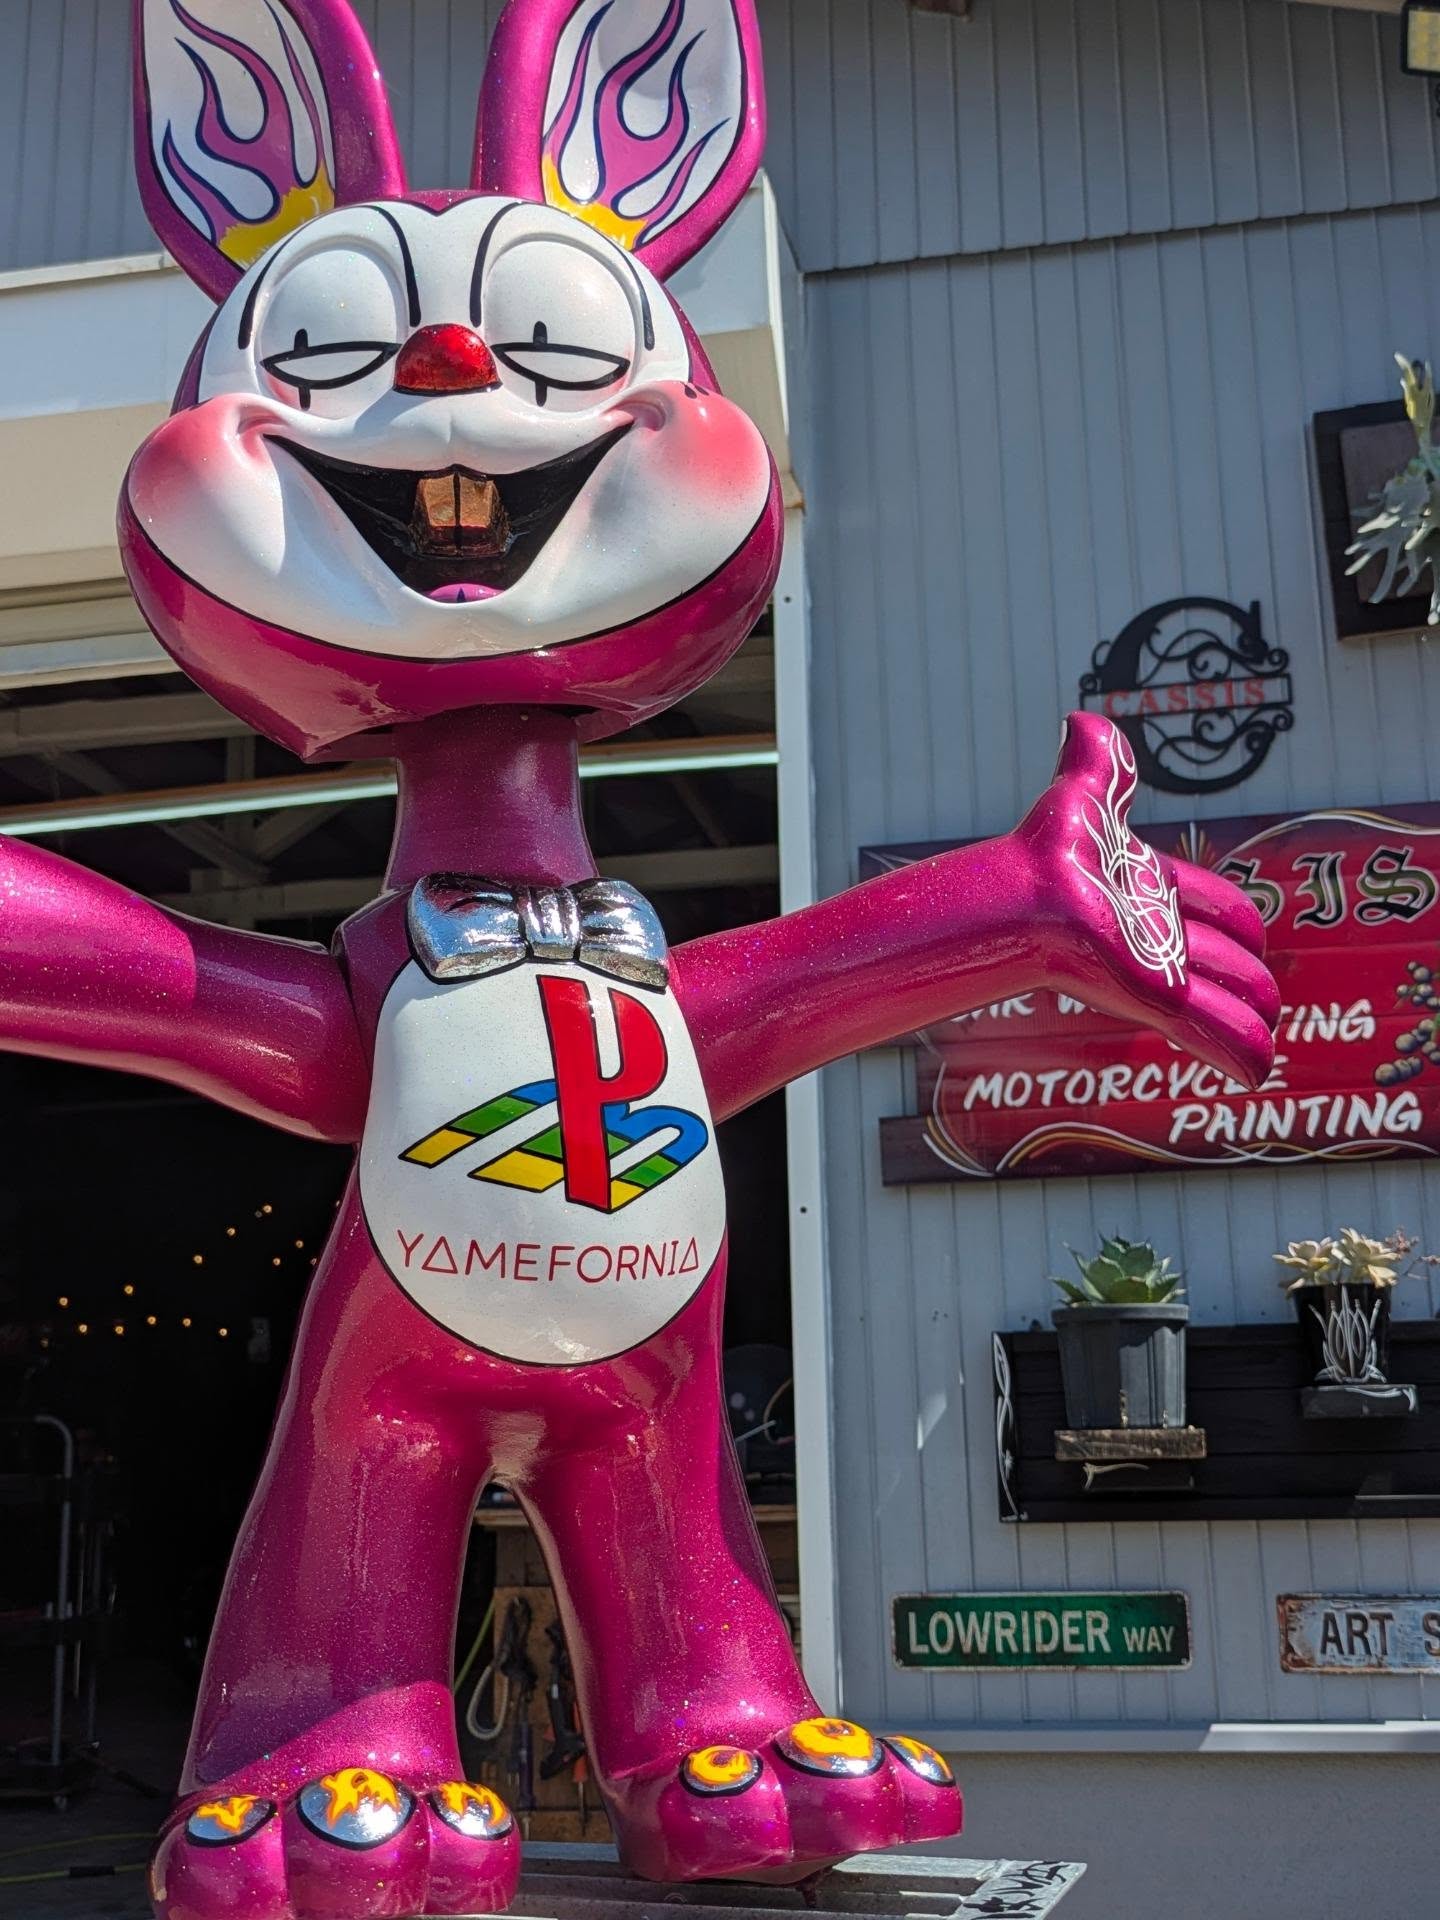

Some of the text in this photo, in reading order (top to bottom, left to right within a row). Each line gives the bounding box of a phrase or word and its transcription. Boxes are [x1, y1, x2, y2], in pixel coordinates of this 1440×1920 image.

[1104, 676, 1266, 719] CASSIS
[1168, 1090, 1423, 1145] PAINTING
[907, 1609, 1175, 1655] LOWRIDER WAY
[1318, 1608, 1395, 1657] ART
